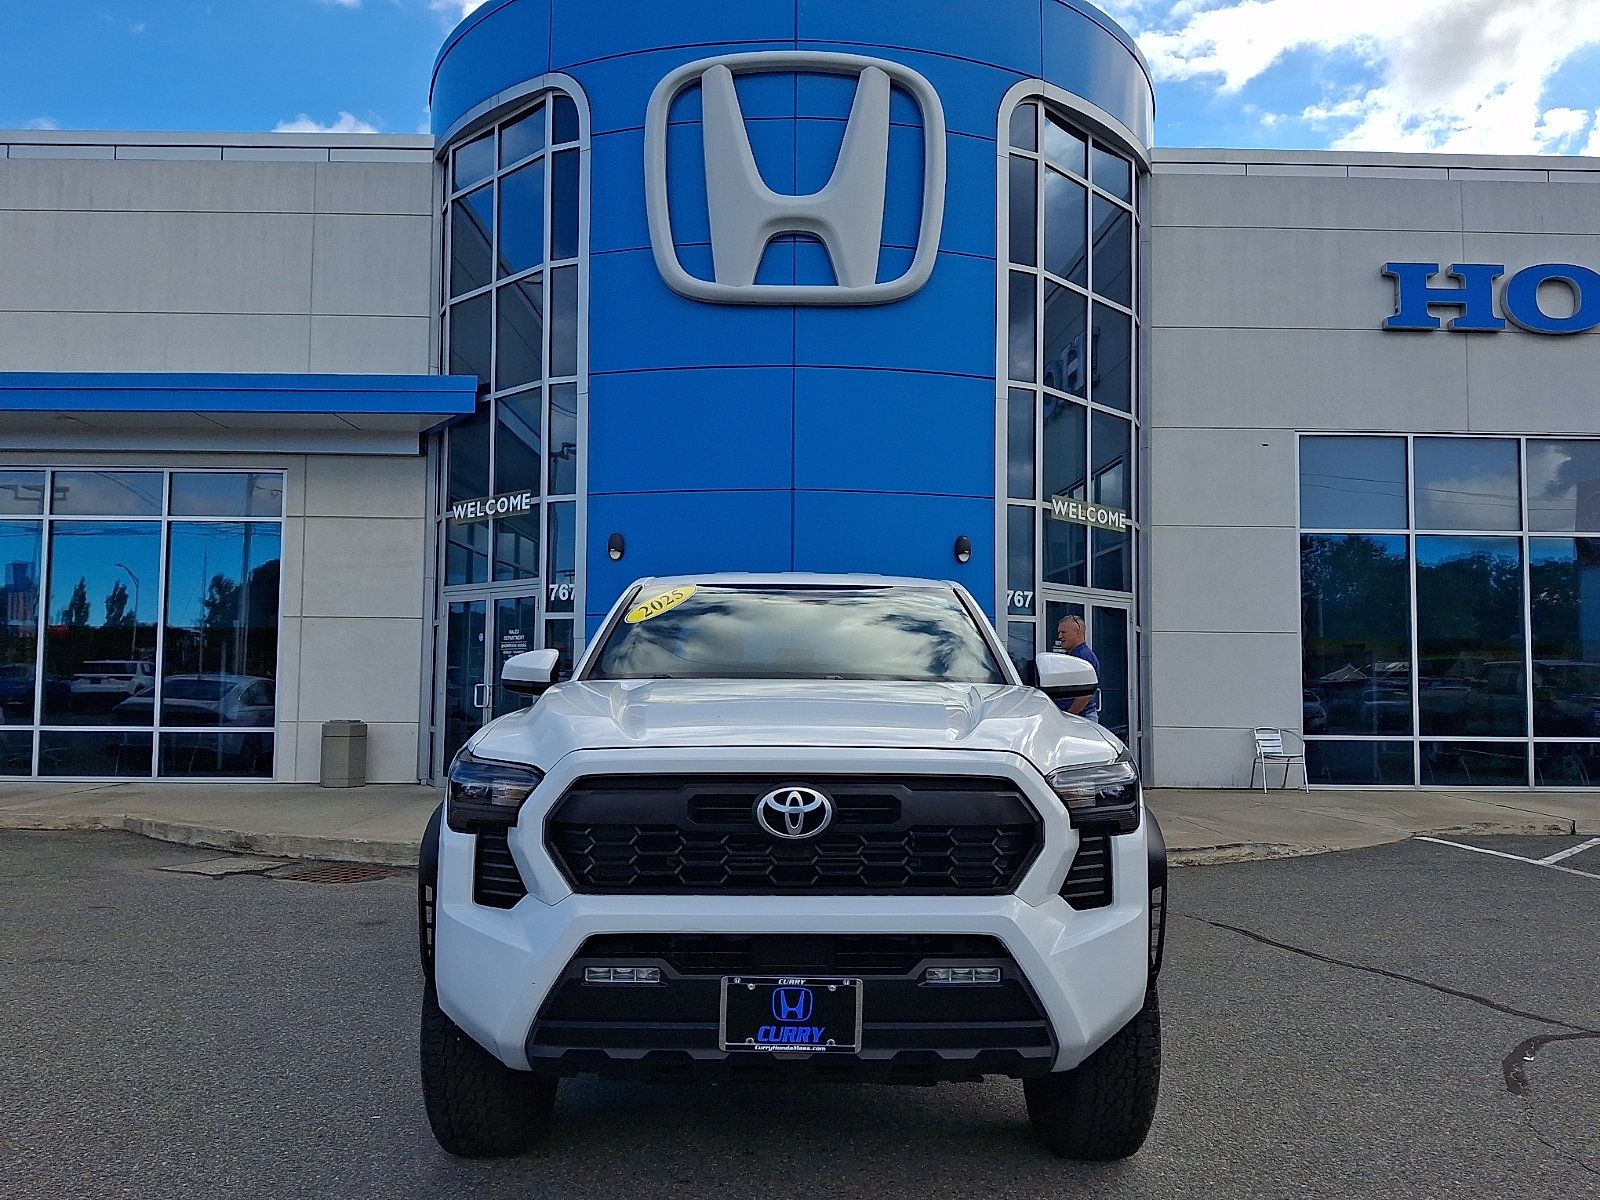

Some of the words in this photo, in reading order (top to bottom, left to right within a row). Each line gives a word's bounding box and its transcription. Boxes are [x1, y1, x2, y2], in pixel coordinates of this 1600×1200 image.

[452, 492, 531, 520] WELCOME
[1052, 498, 1127, 529] WELCOME
[549, 583, 576, 601] 767
[1006, 590, 1034, 608] 767
[638, 589, 684, 618] 2025
[778, 978, 806, 986] CURRY
[757, 1025, 826, 1043] CURRY
